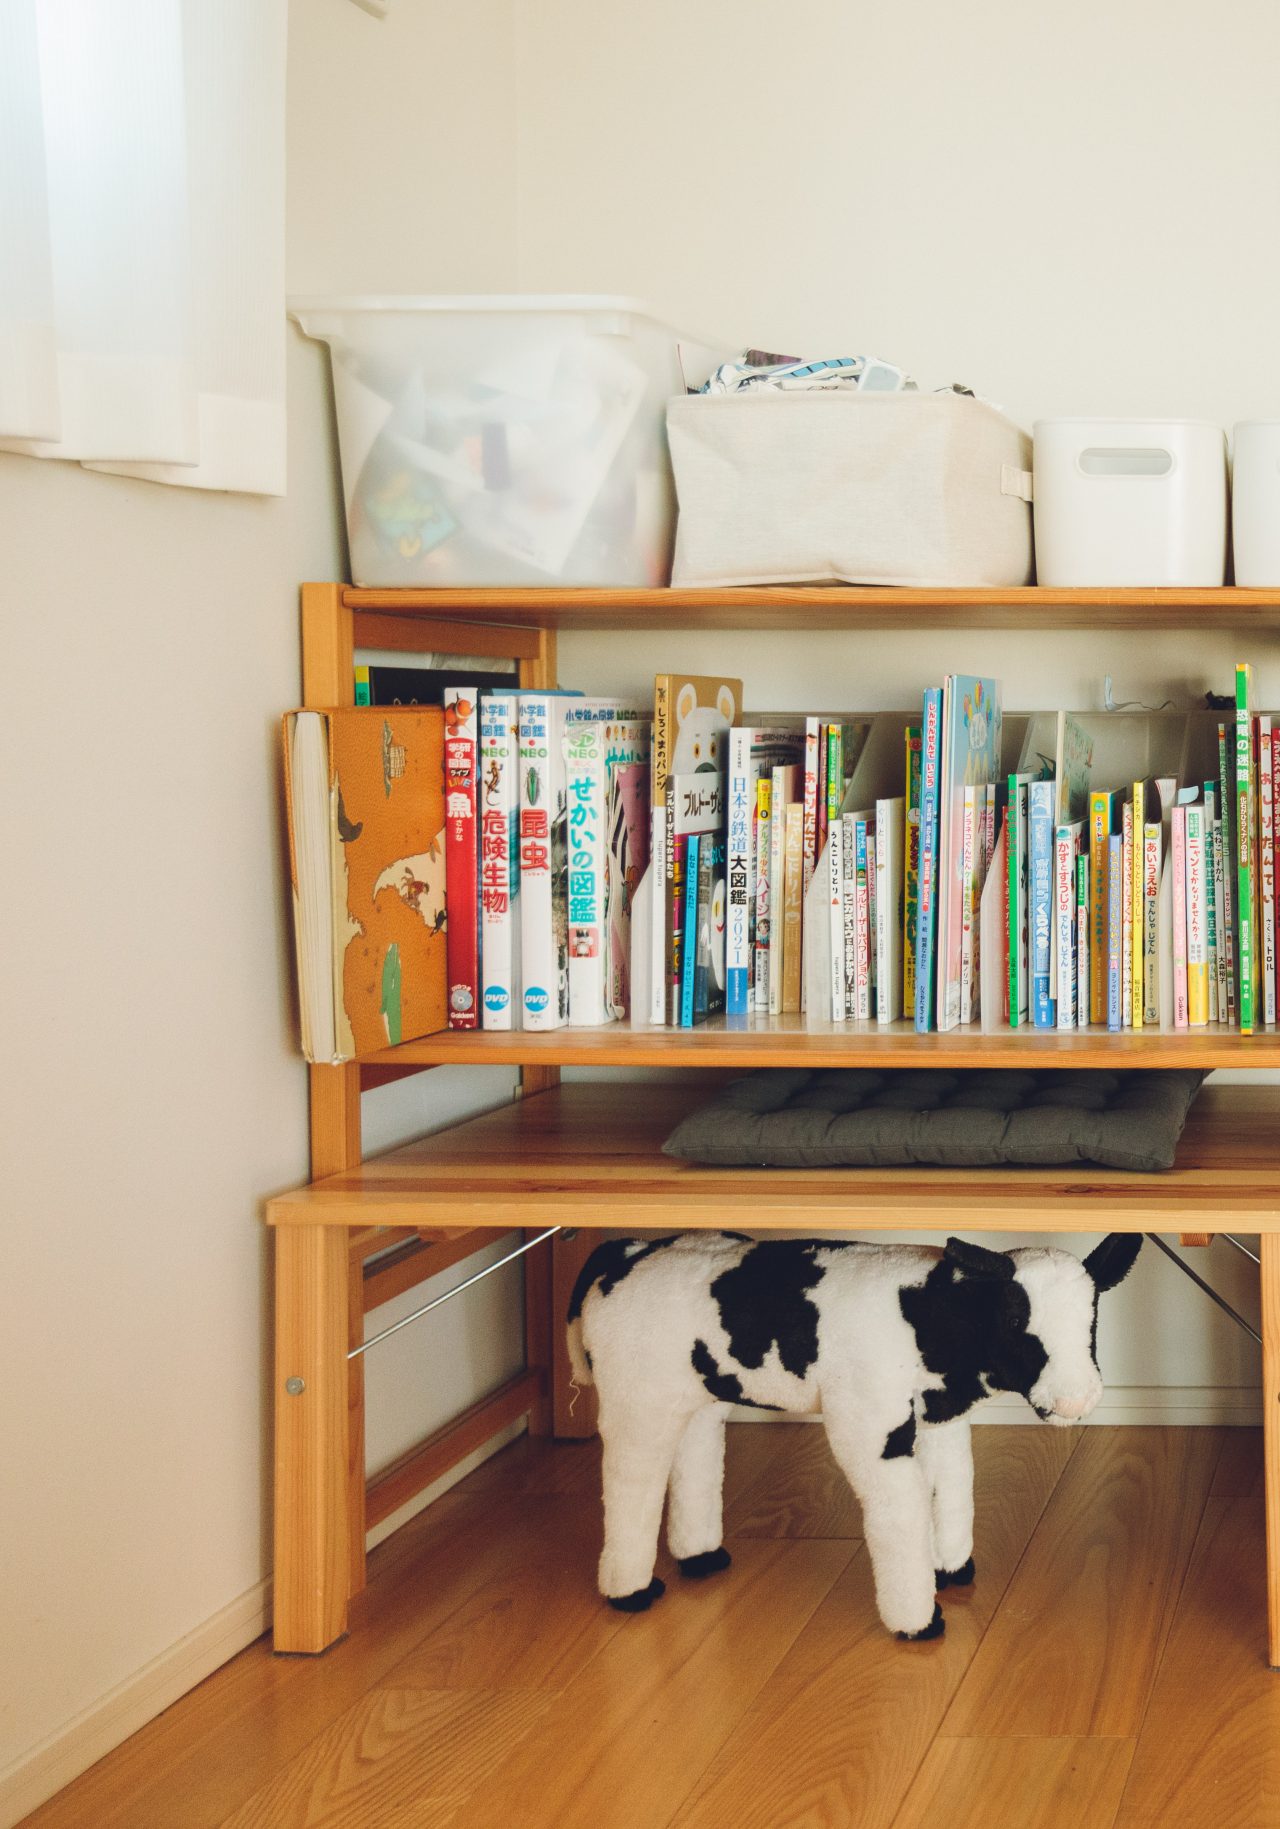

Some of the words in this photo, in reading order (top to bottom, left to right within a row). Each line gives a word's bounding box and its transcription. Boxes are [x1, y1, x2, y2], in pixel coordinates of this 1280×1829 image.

[481, 748, 509, 758] NEO
[520, 748, 547, 758] NEO
[567, 749, 599, 759] NEO
[656, 707, 668, 791] しろくまのパンツ
[927, 703, 936, 760] しんかんせんで
[1236, 709, 1249, 781] 恐竜の迷路
[448, 778, 472, 788] LIVE
[927, 763, 935, 788] いこう
[447, 792, 473, 818] 魚
[731, 777, 748, 853] 日本の鉄道
[804, 771, 817, 859] おしりたんてい
[455, 820, 464, 841] さかな
[520, 808, 549, 870] 昆虫
[569, 776, 599, 923] せかいの図鑑
[877, 808, 885, 857] ぐりとぐら
[1261, 773, 1274, 904] おしりたんてい
[481, 809, 509, 914] 危険生物
[730, 855, 747, 905] 大図鑑
[1058, 843, 1070, 911] かずとすうじの
[1146, 842, 1157, 897] あいうえお
[1147, 900, 1156, 928] でんしゃ
[1189, 839, 1200, 941] ニャンとかなりませんか?
[733, 908, 743, 964] 2021
[1060, 915, 1069, 942] でんしゃ
[1147, 933, 1156, 955] じてん
[1060, 946, 1069, 968] じてん
[484, 993, 509, 1003] DVD
[524, 994, 548, 1004] DVD
